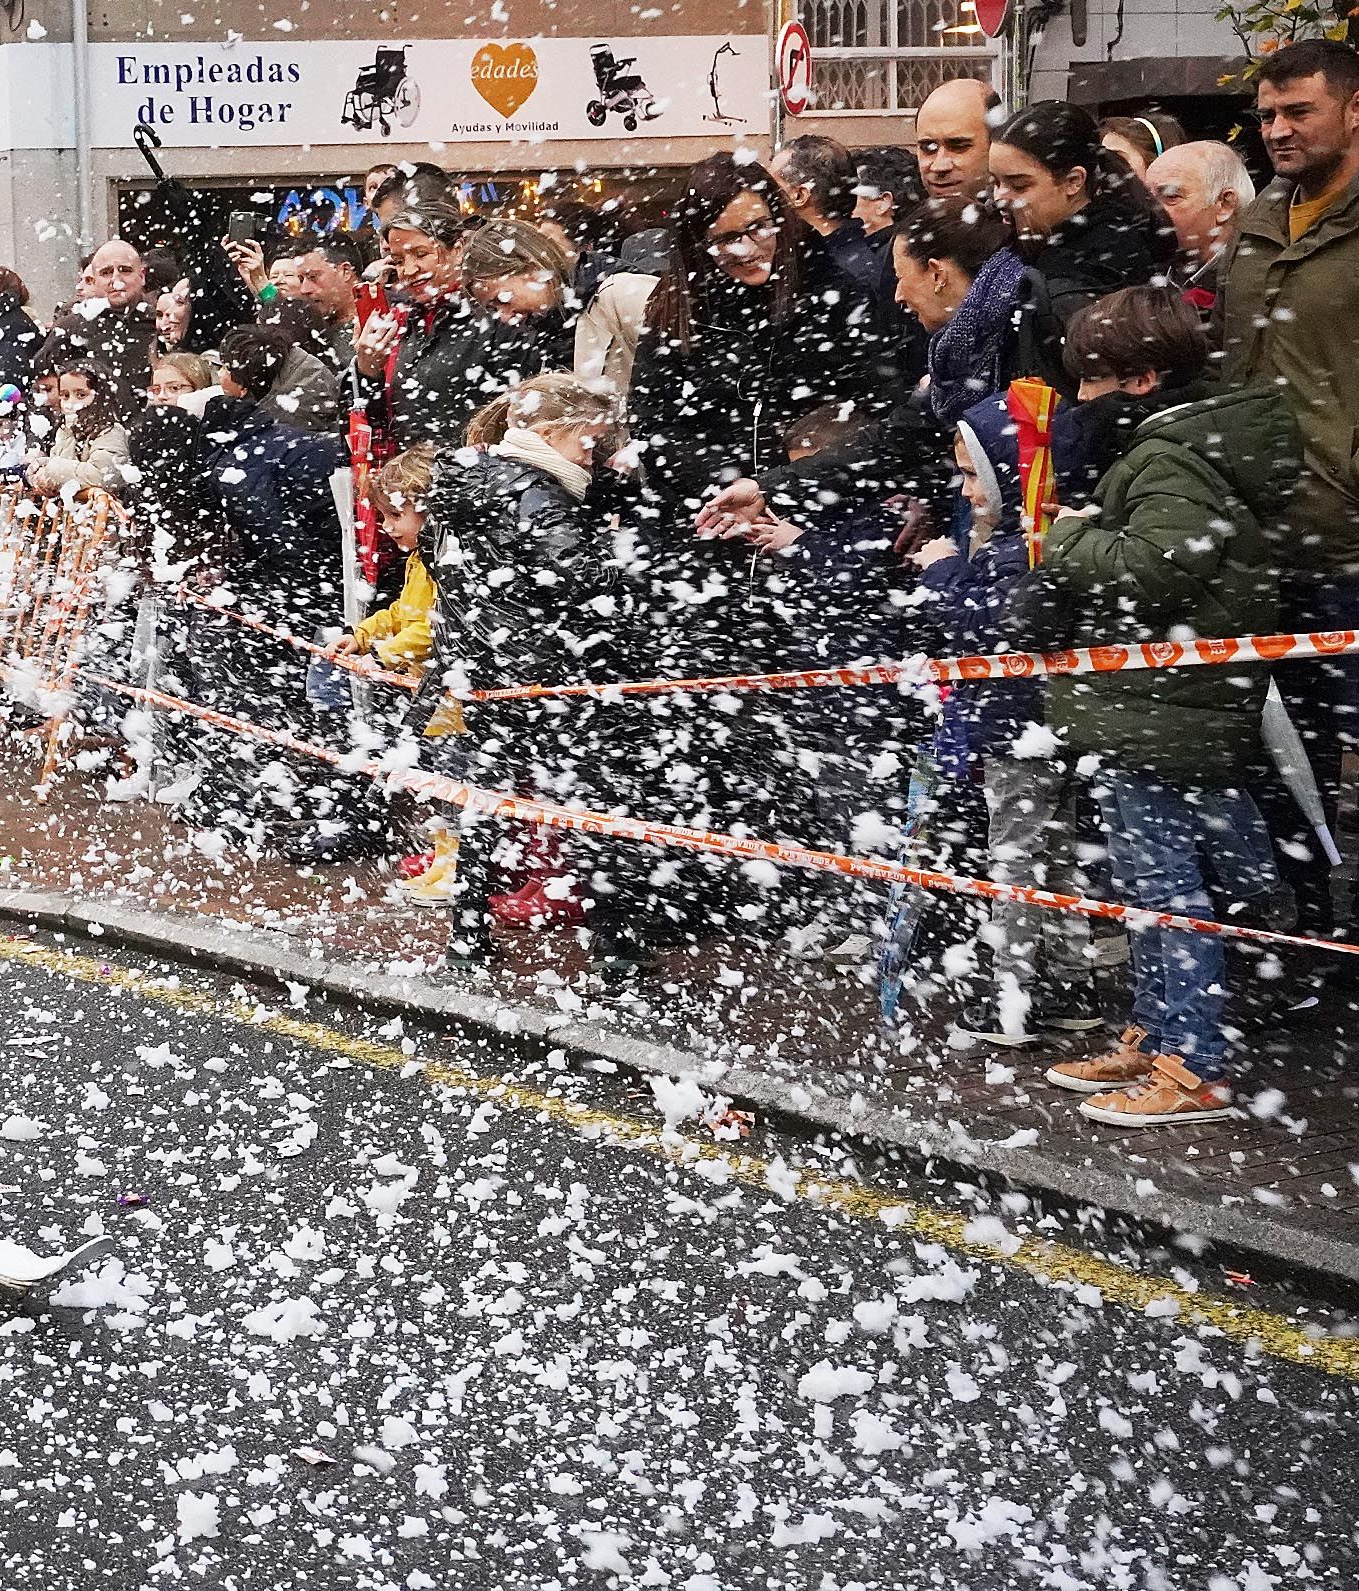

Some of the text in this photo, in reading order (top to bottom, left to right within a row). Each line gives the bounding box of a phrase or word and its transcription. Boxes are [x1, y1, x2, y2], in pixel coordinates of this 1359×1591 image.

[116, 56, 300, 92] Empleadas
[470, 58, 539, 79] edades
[137, 97, 292, 131] de Hogar
[452, 122, 559, 134] Ayudas y Movilidad
